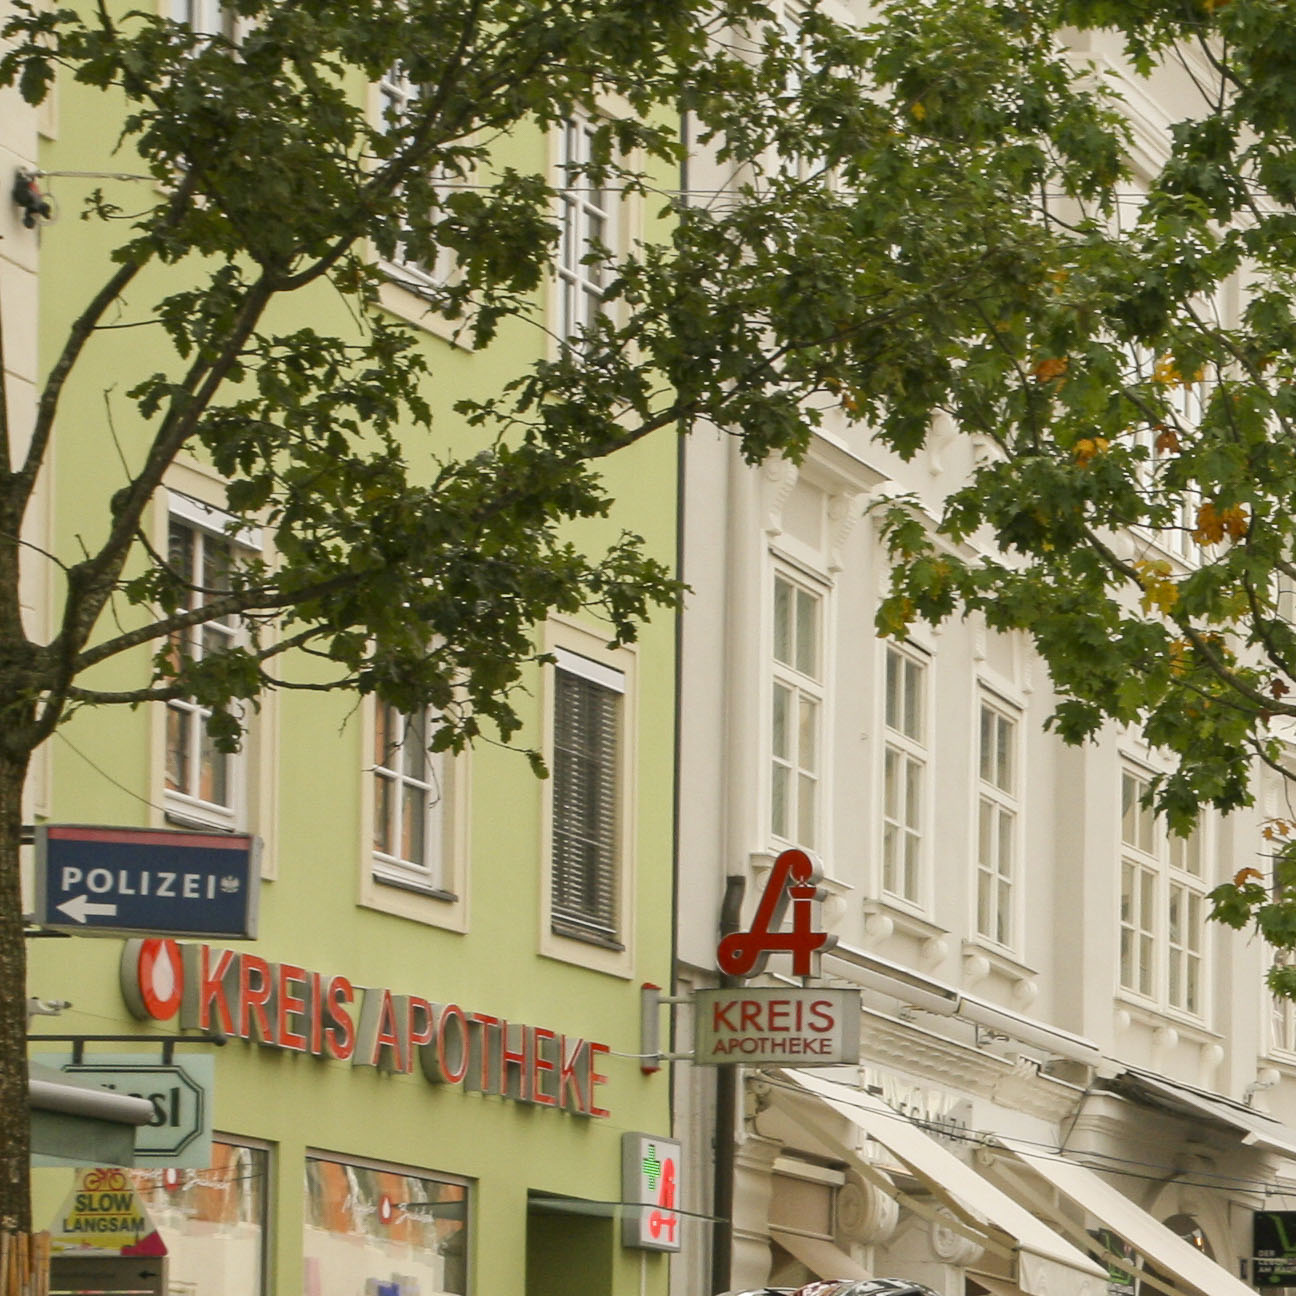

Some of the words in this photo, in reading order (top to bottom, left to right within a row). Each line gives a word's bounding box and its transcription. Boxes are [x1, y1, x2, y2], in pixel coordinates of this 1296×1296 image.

[61, 865, 216, 900] POLIZEI
[712, 999, 836, 1033] KREIS
[200, 943, 355, 1062] KREIS
[371, 988, 611, 1119] APOTHEKE
[711, 1037, 833, 1055] APOTHEKE
[74, 1193, 134, 1213] SLOW
[62, 1217, 145, 1234] LANGSAM
